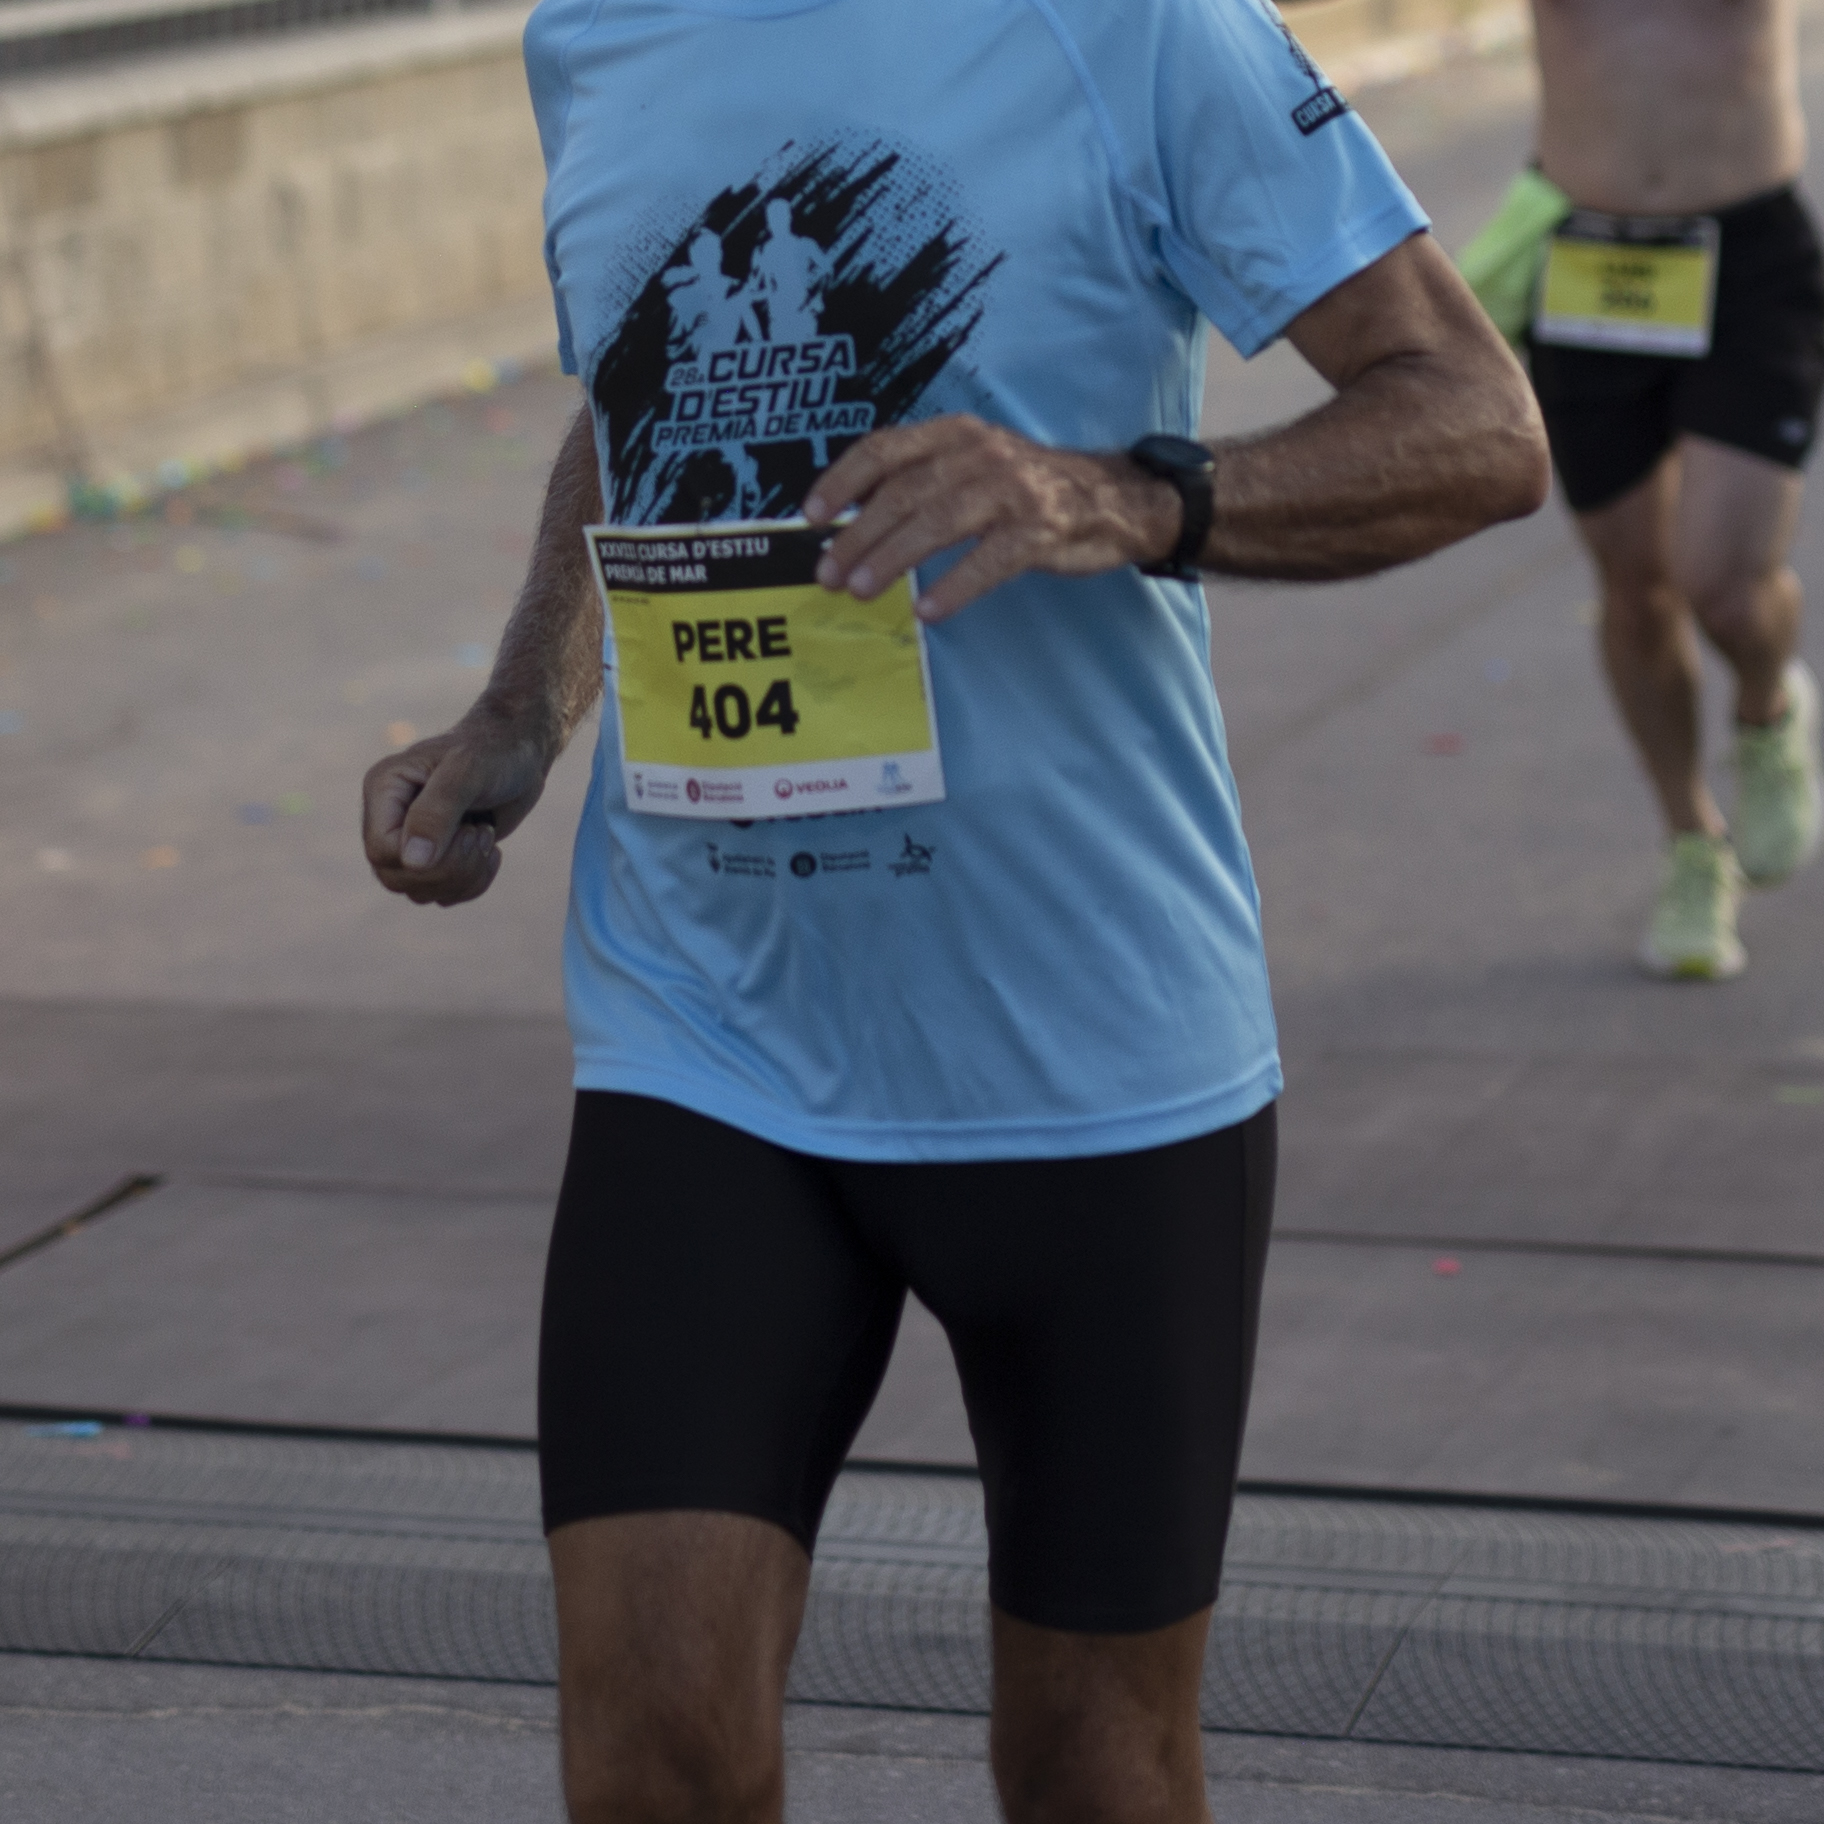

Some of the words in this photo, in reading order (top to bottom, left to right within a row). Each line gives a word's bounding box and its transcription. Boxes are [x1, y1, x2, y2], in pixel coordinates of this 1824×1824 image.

[708, 340, 851, 383] CURSA
[677, 377, 830, 422] D'ESTIU
[762, 411, 803, 437] DE
[805, 406, 871, 432] MAR
[637, 541, 689, 561] CURSA
[691, 536, 770, 560] D'ESTIU
[646, 565, 667, 584] DE
[669, 564, 708, 583] MAR
[671, 616, 792, 663] PERE
[689, 679, 799, 739] 404
[796, 778, 849, 794] VEOLIA
